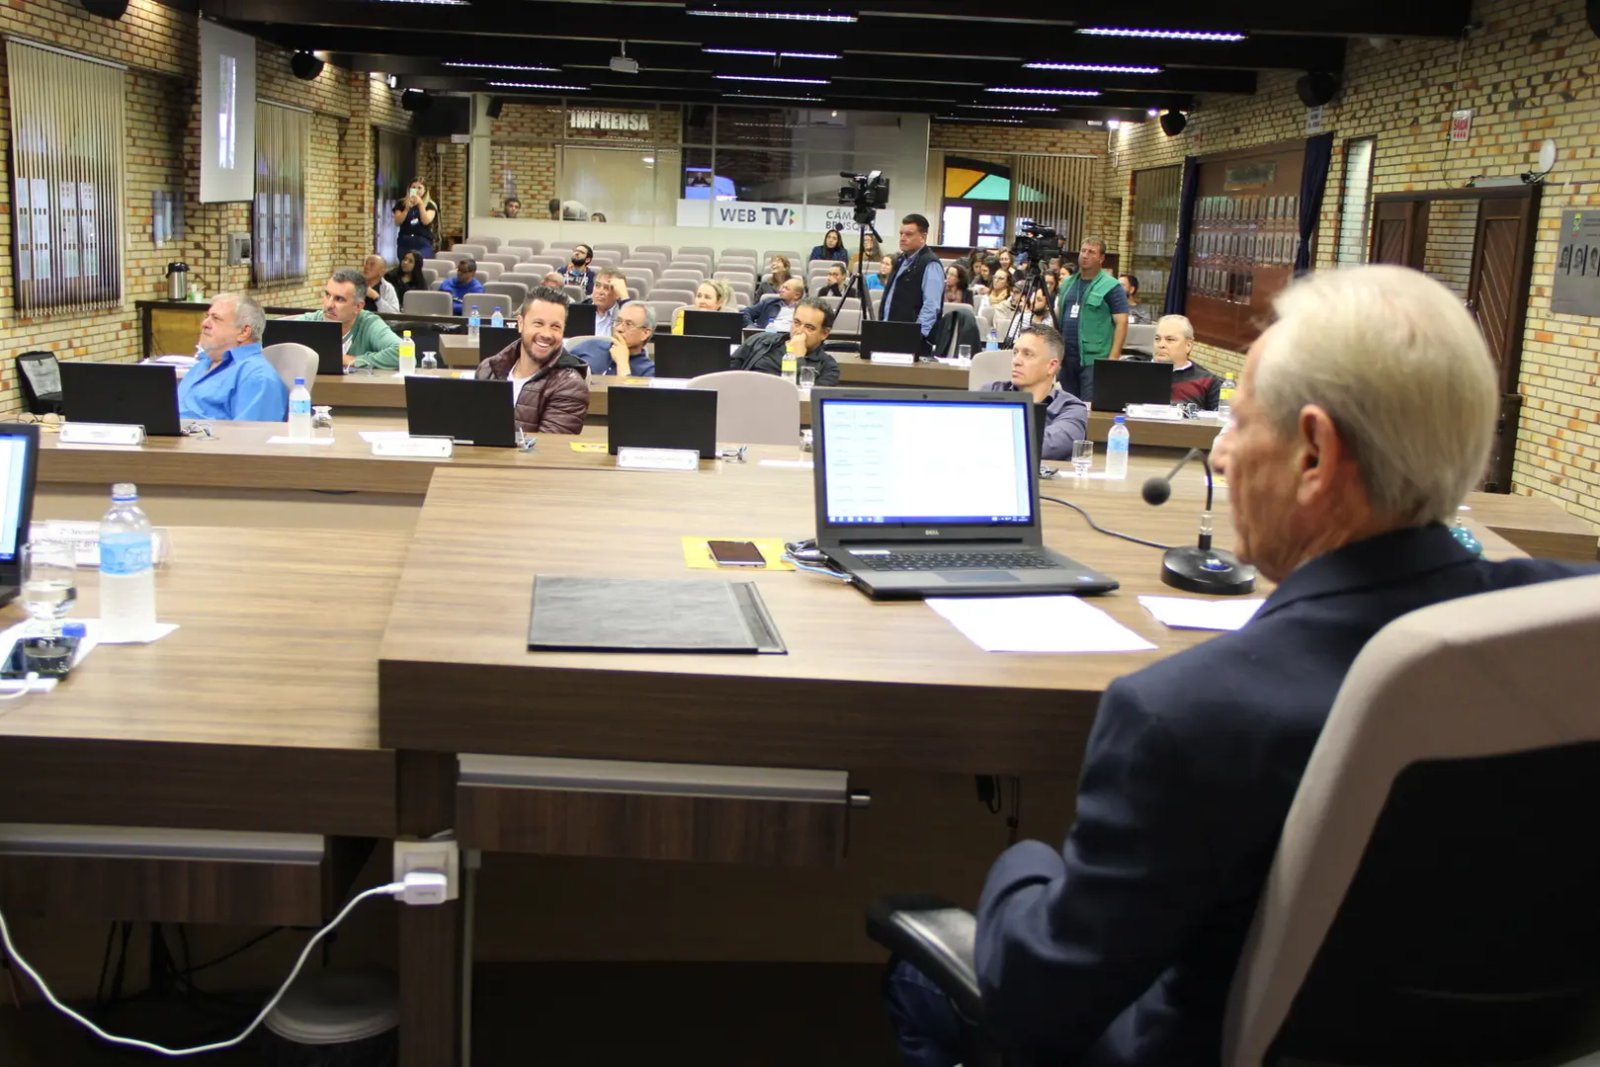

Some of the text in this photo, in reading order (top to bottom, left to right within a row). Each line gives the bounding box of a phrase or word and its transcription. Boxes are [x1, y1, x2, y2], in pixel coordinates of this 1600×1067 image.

[570, 111, 649, 130] IMPRENSA
[720, 207, 788, 225] WEB TV
